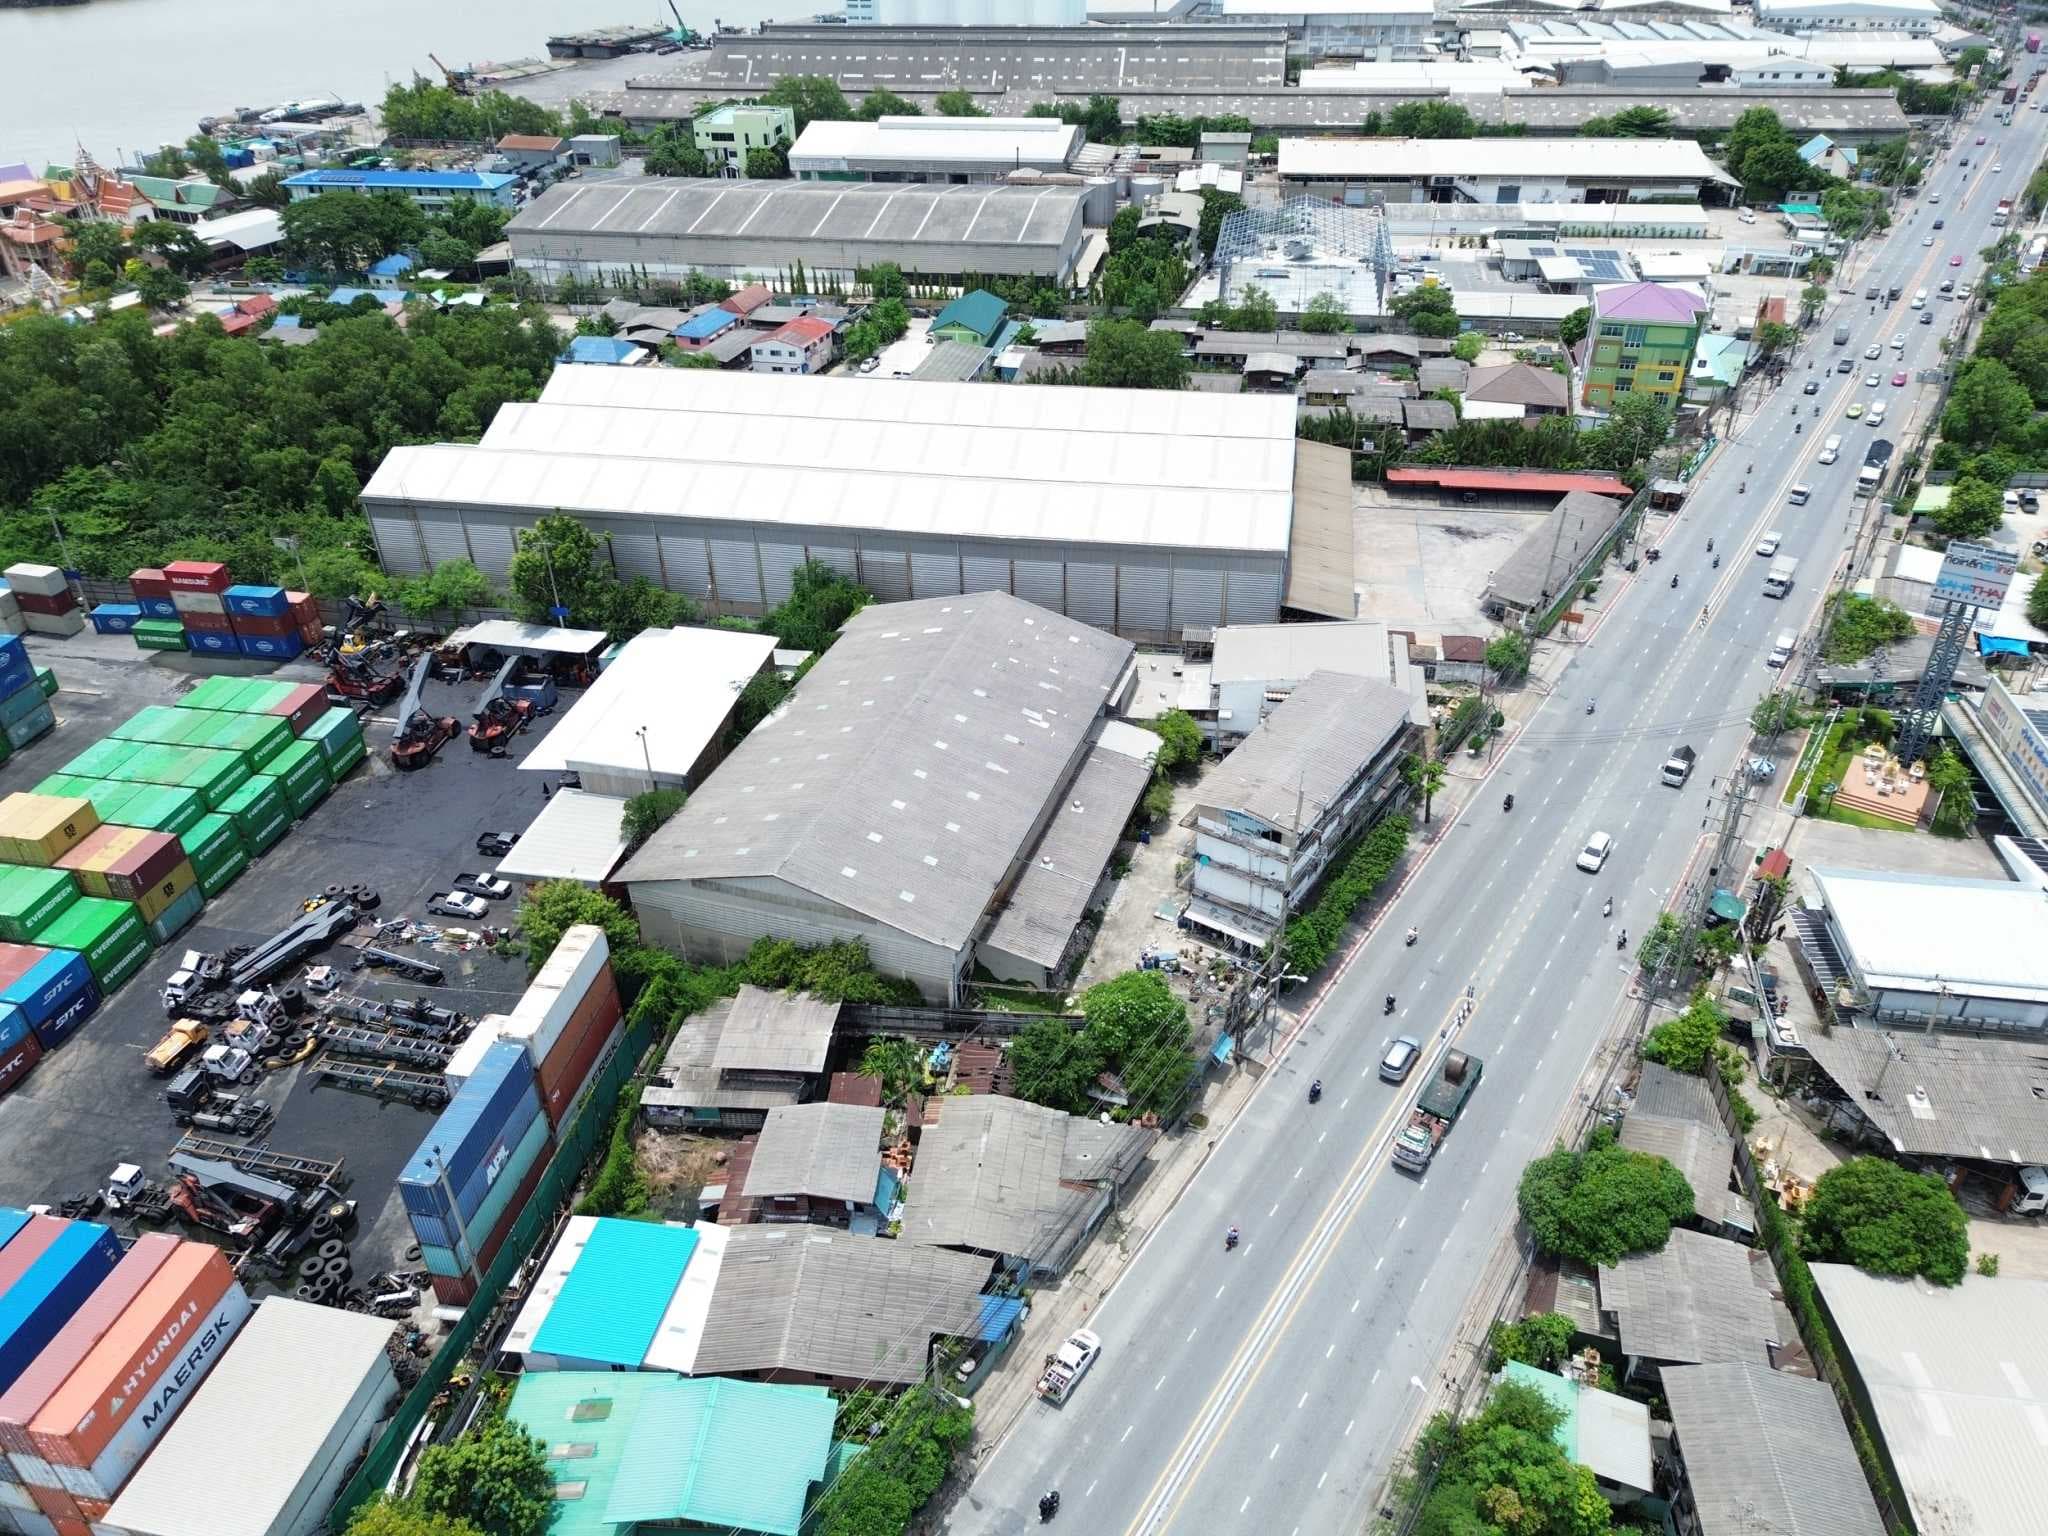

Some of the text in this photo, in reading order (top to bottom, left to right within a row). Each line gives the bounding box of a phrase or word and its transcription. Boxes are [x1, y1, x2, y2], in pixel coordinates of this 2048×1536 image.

[138, 634, 181, 644] EVERGREEN
[254, 729, 289, 761] EVERGREEN
[209, 764, 247, 799] EVERGREEN
[287, 753, 321, 786] EVERGREEN
[204, 850, 243, 889] EVERGREEN
[25, 884, 73, 928] EVERGREEN
[90, 915, 137, 960] EVERGREEN
[103, 940, 147, 984] EVERGREEN
[43, 973, 73, 1006] SITC
[55, 997, 85, 1031] SITC
[122, 1301, 198, 1395] HYUNDAI
[142, 1311, 230, 1430] MAERSK
